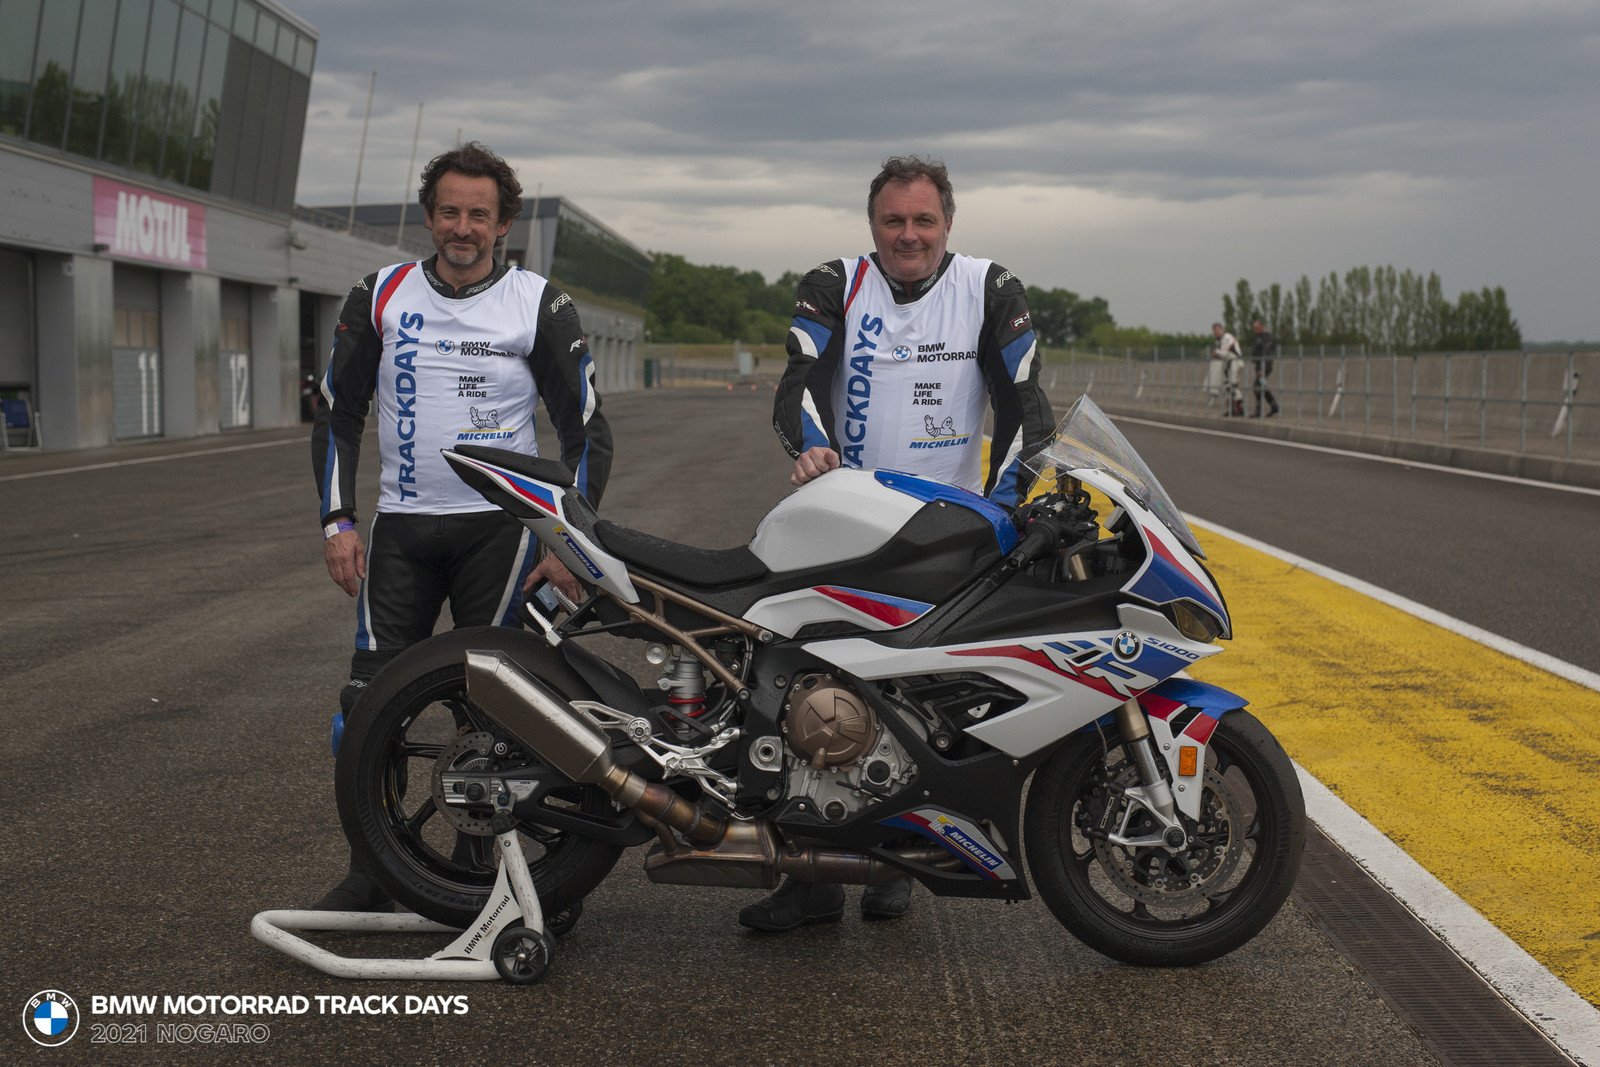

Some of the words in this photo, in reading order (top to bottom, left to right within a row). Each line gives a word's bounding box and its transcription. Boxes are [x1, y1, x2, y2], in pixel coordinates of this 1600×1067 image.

[114, 190, 191, 262] MOTUL
[1014, 312, 1029, 327] R-1
[917, 342, 945, 353] BMW
[917, 351, 977, 362] MOTORRAD
[138, 352, 160, 435] 11
[230, 353, 250, 426] 12
[394, 311, 424, 502] TRACKDAYS
[842, 312, 883, 469] ACKDAYS
[457, 431, 515, 440] MICHELIN
[909, 437, 969, 449] MICHELIN
[567, 541, 598, 574] MICHELIN
[1144, 637, 1201, 660] S1000
[949, 831, 999, 866] MICHELIN
[464, 931, 482, 954] BMW
[480, 894, 510, 933] Motorrad
